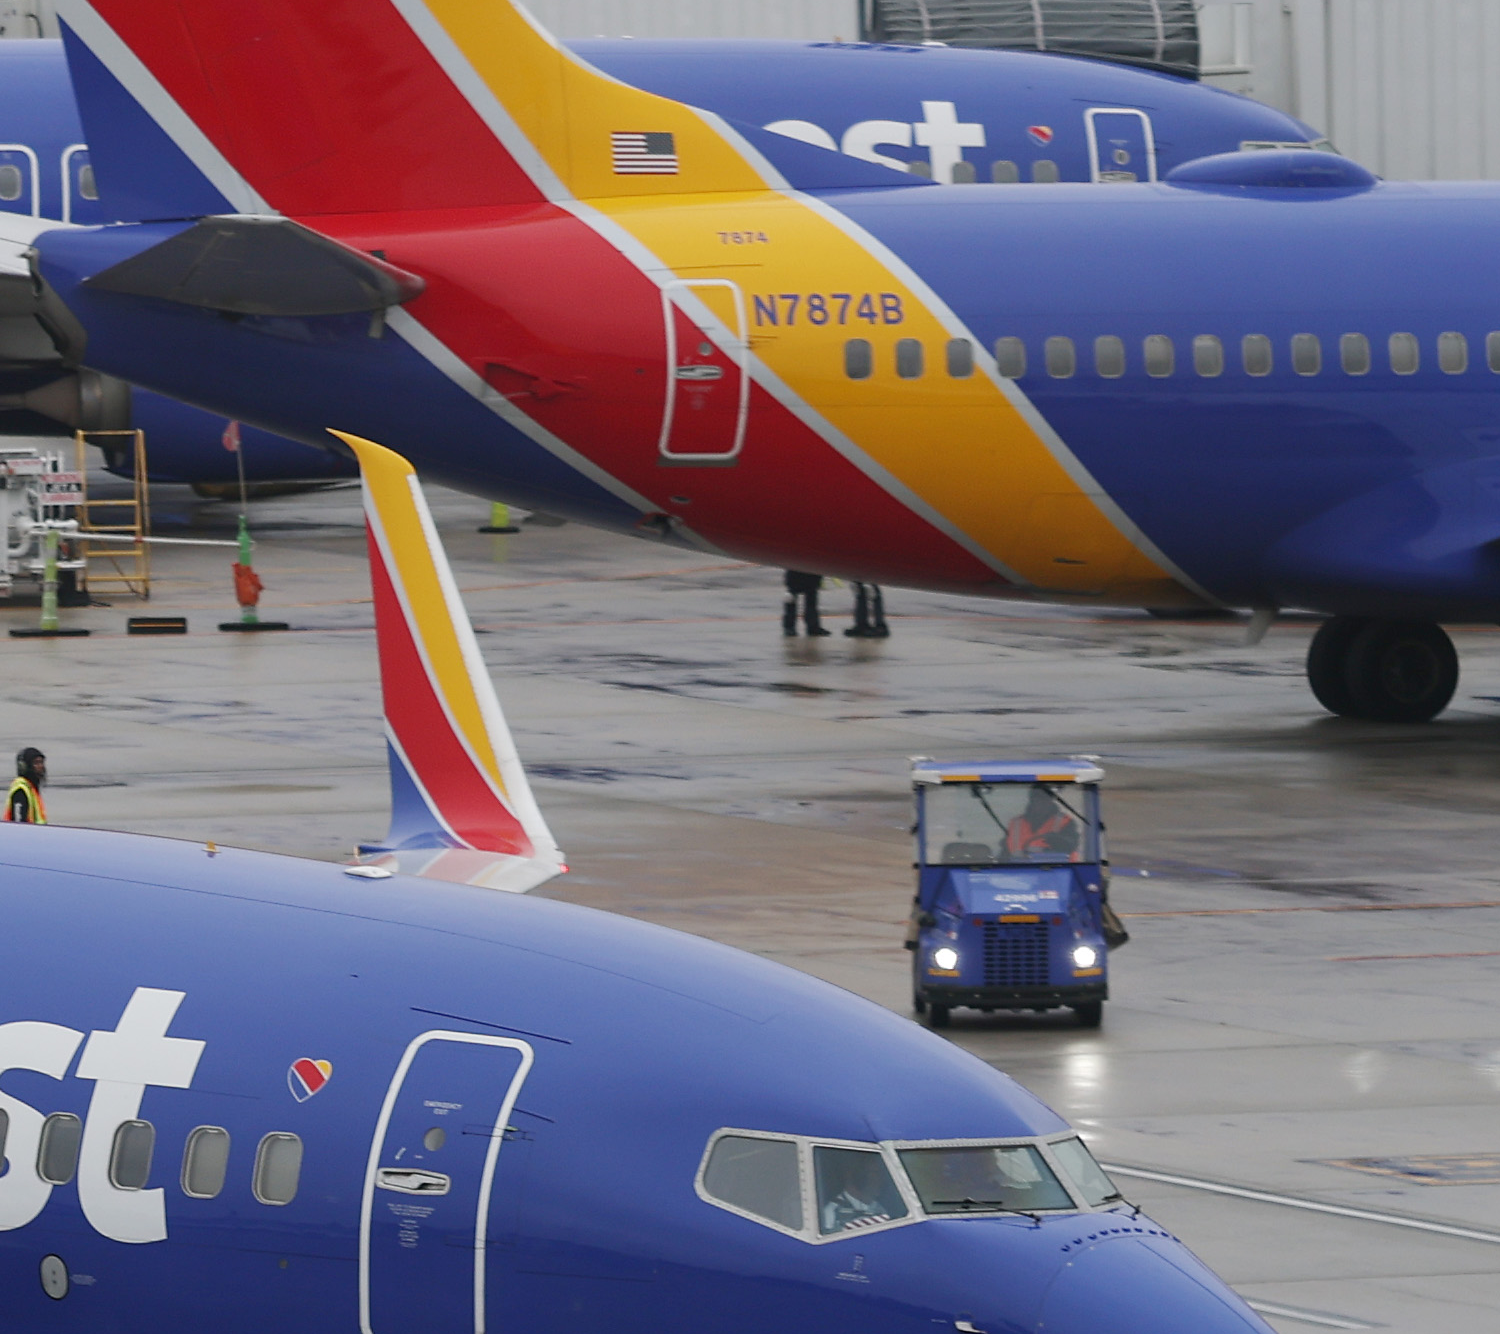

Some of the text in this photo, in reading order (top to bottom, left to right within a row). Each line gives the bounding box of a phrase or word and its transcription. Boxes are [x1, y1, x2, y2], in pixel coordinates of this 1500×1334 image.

[761, 100, 987, 185] st
[717, 231, 769, 245] 7874
[752, 292, 904, 327] N7874B
